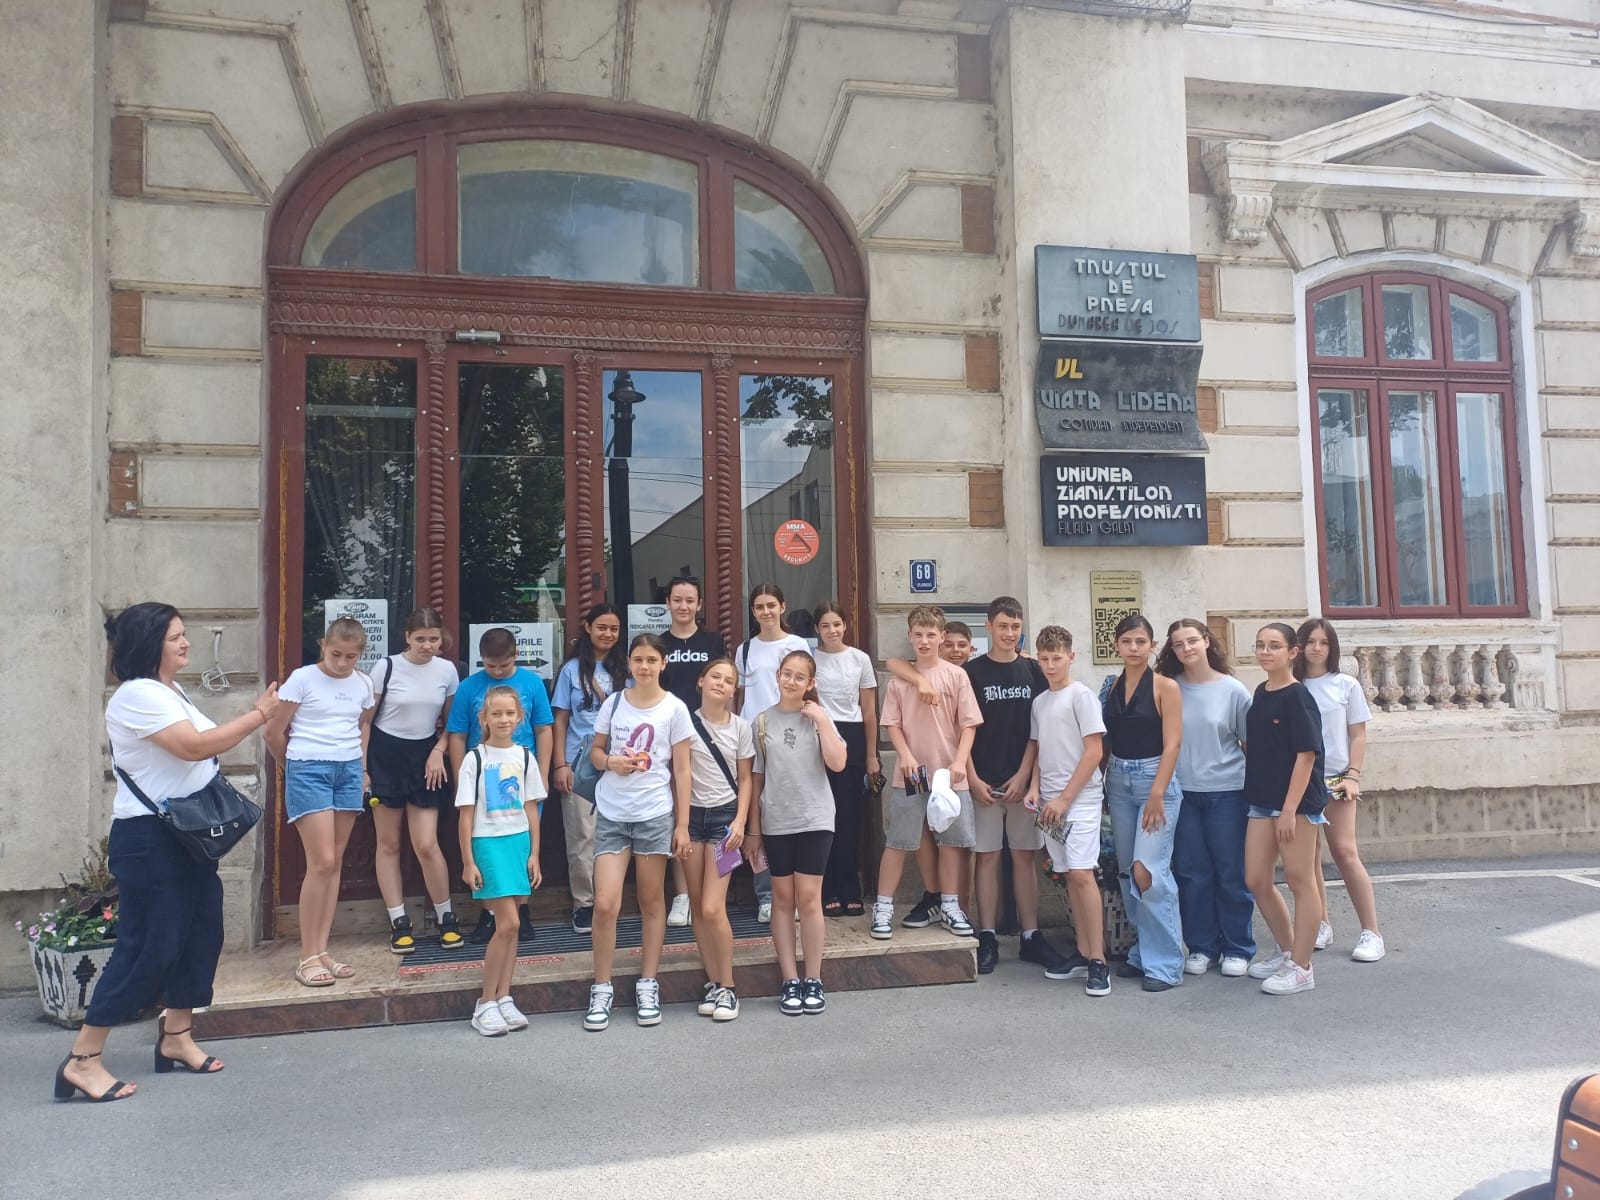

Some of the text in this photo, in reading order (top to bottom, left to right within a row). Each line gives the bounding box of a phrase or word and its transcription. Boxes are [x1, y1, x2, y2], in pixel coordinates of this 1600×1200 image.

[1108, 279, 1134, 295] DE
[1055, 358, 1084, 379] VL
[1056, 466, 1134, 483] UNIUNEA
[783, 553, 811, 563] SECURITY
[916, 564, 931, 580] 68
[983, 684, 1031, 703] Blessed
